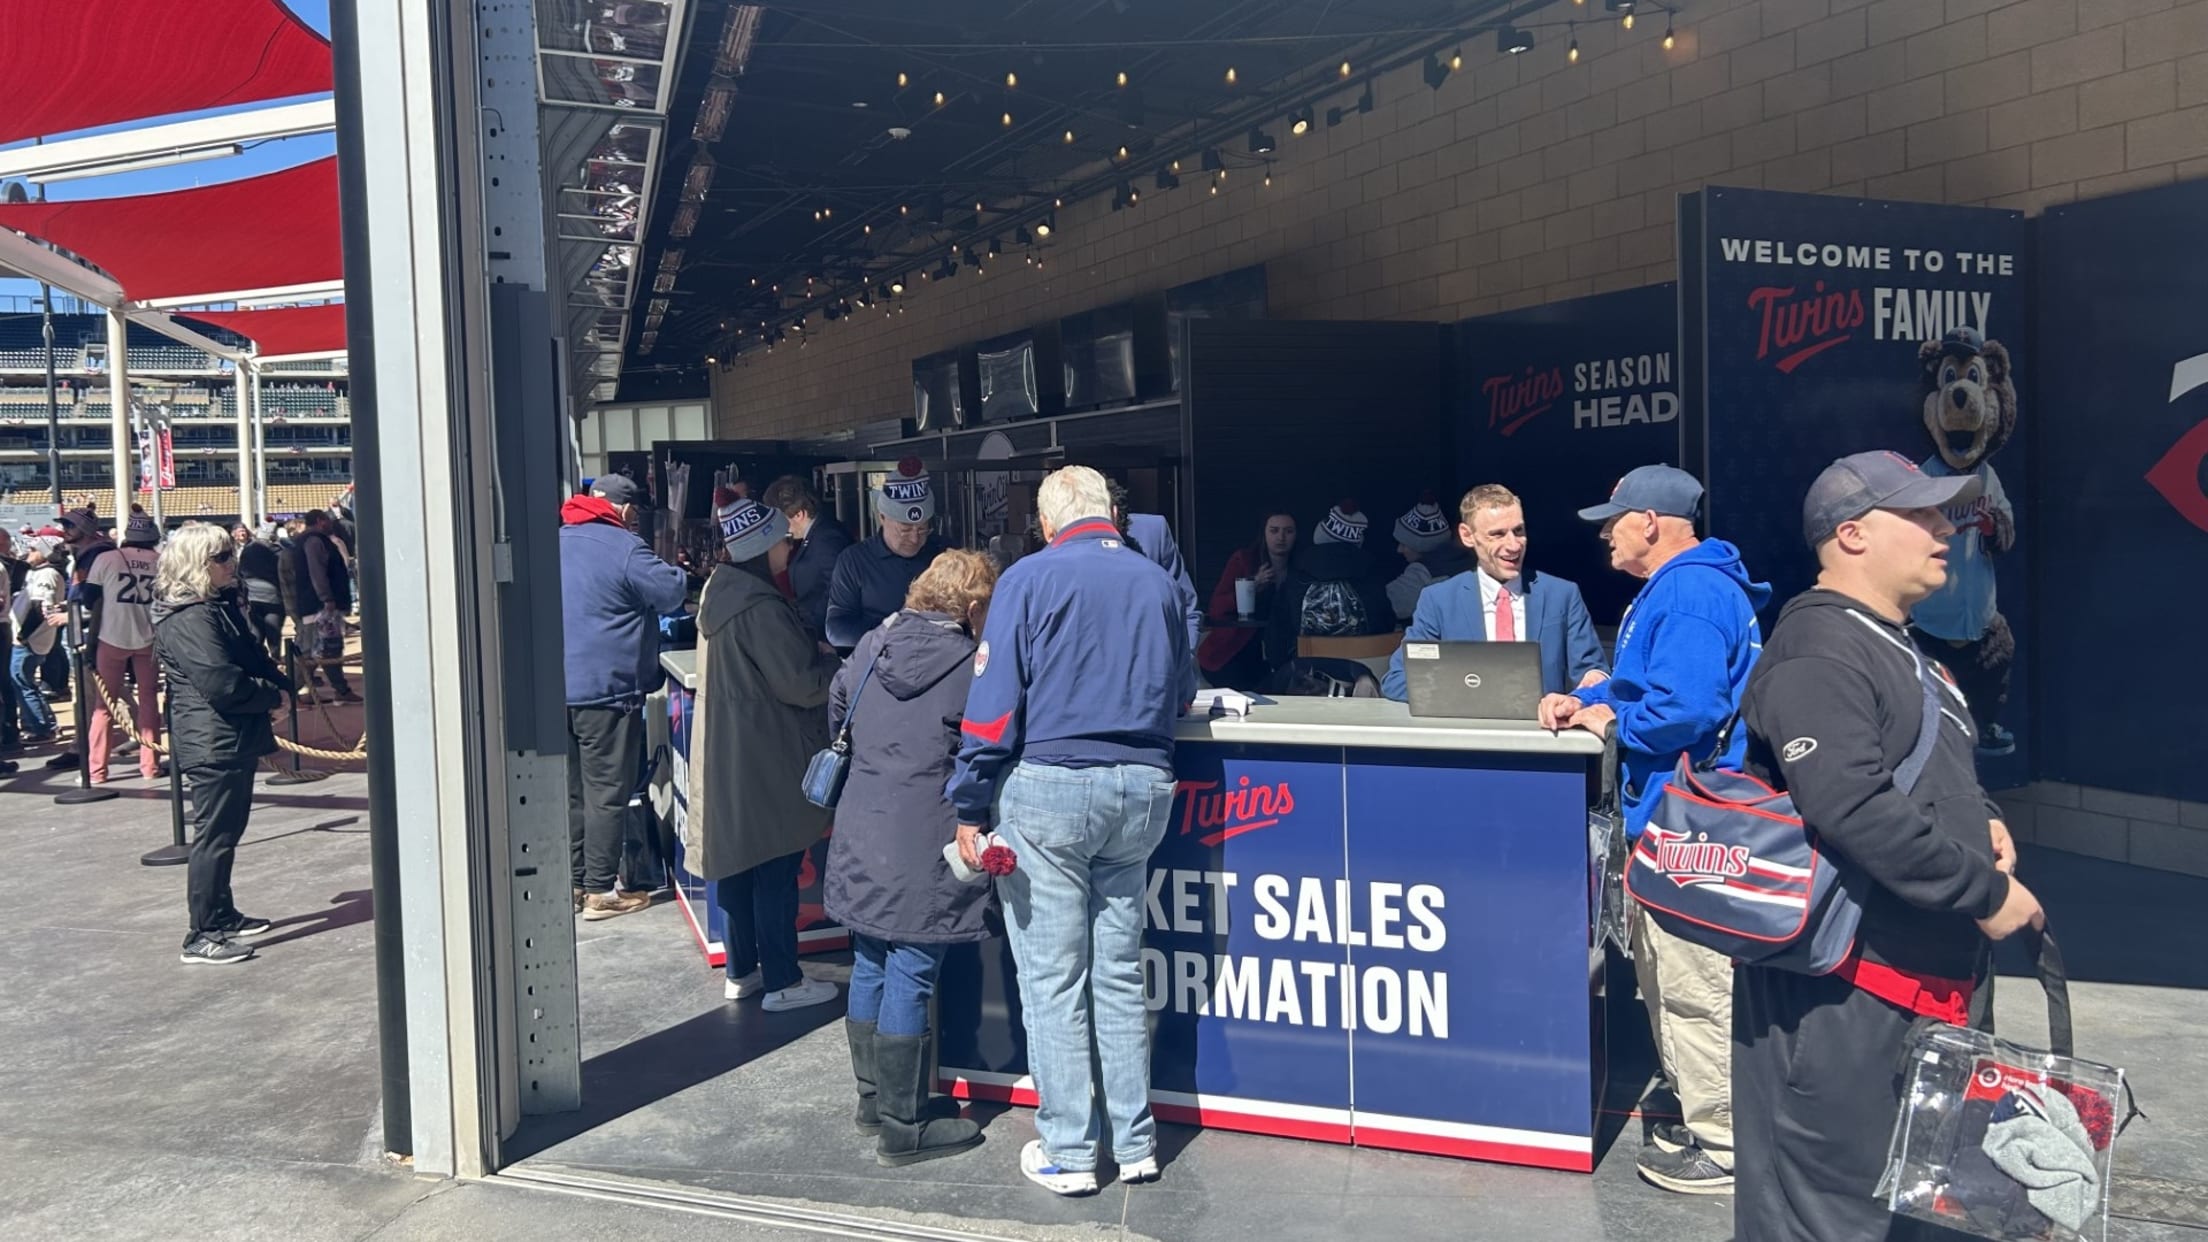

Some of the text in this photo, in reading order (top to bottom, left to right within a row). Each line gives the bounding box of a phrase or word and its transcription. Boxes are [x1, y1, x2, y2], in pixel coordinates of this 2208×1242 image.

[1721, 238, 2015, 276] WELCOME TO THE
[1747, 280, 1865, 360] Twins
[1574, 352, 1671, 392] SEASON
[1482, 366, 1563, 429] Twins
[1573, 391, 1680, 429] HEAD
[117, 572, 154, 605] 23
[1176, 776, 1294, 842] Twins
[1654, 830, 1750, 880] Twins
[1253, 873, 1446, 953] SALES
